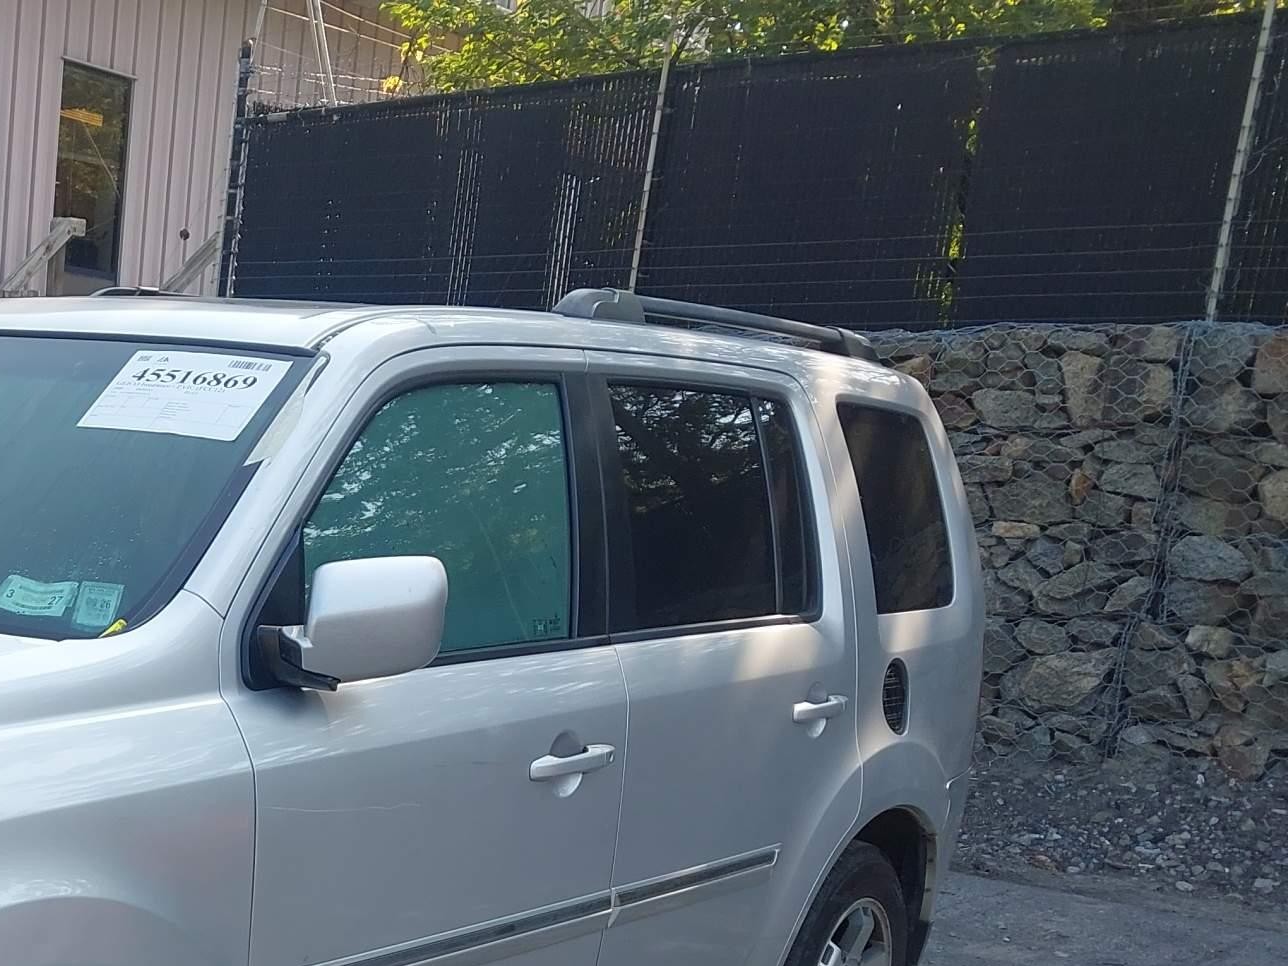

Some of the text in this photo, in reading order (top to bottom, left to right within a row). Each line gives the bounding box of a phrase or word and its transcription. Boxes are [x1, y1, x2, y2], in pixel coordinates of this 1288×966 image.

[132, 367, 258, 390] 45516869
[6, 589, 15, 598] 3
[47, 595, 64, 606] 27
